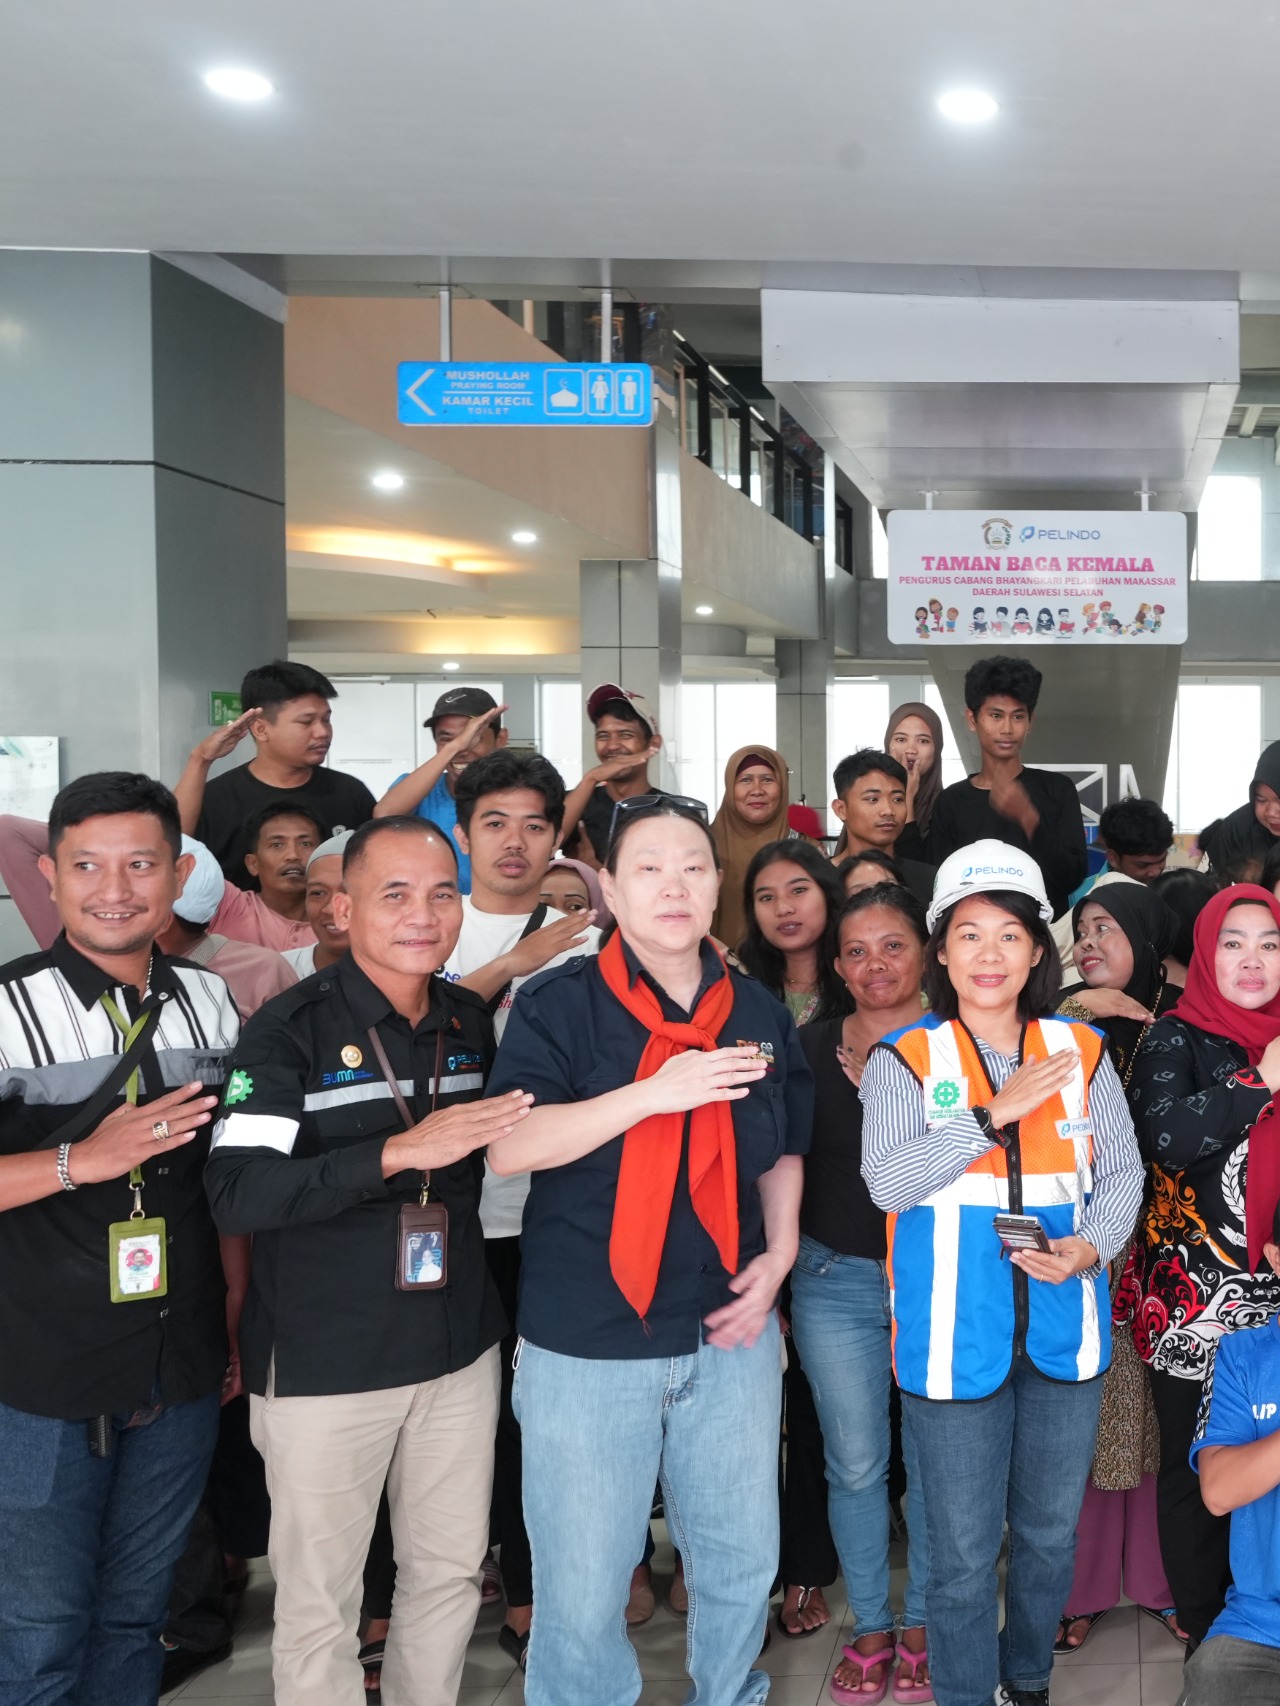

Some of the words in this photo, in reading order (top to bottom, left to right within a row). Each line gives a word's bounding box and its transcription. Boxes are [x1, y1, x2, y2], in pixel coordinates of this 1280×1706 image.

[446, 371, 530, 380] MUSHOLLAH
[442, 396, 490, 406] KAMAR
[494, 396, 534, 406] KECIL
[1038, 530, 1101, 540] PELINDO
[921, 556, 1001, 571] TAMAN
[1006, 557, 1062, 572] BACA
[1067, 557, 1154, 572] KEMALA
[899, 577, 952, 585] PENGURUS
[953, 577, 993, 585] CABANG
[996, 577, 1062, 585] BHAYANGKARI
[1065, 577, 1121, 586] PELABUHAN
[1123, 578, 1176, 586] MAKASSAR
[972, 588, 1010, 596] DAERAH
[1013, 588, 1061, 597] SULAWESI
[1063, 588, 1104, 597] SELATAN
[975, 866, 1024, 877] PELINDO
